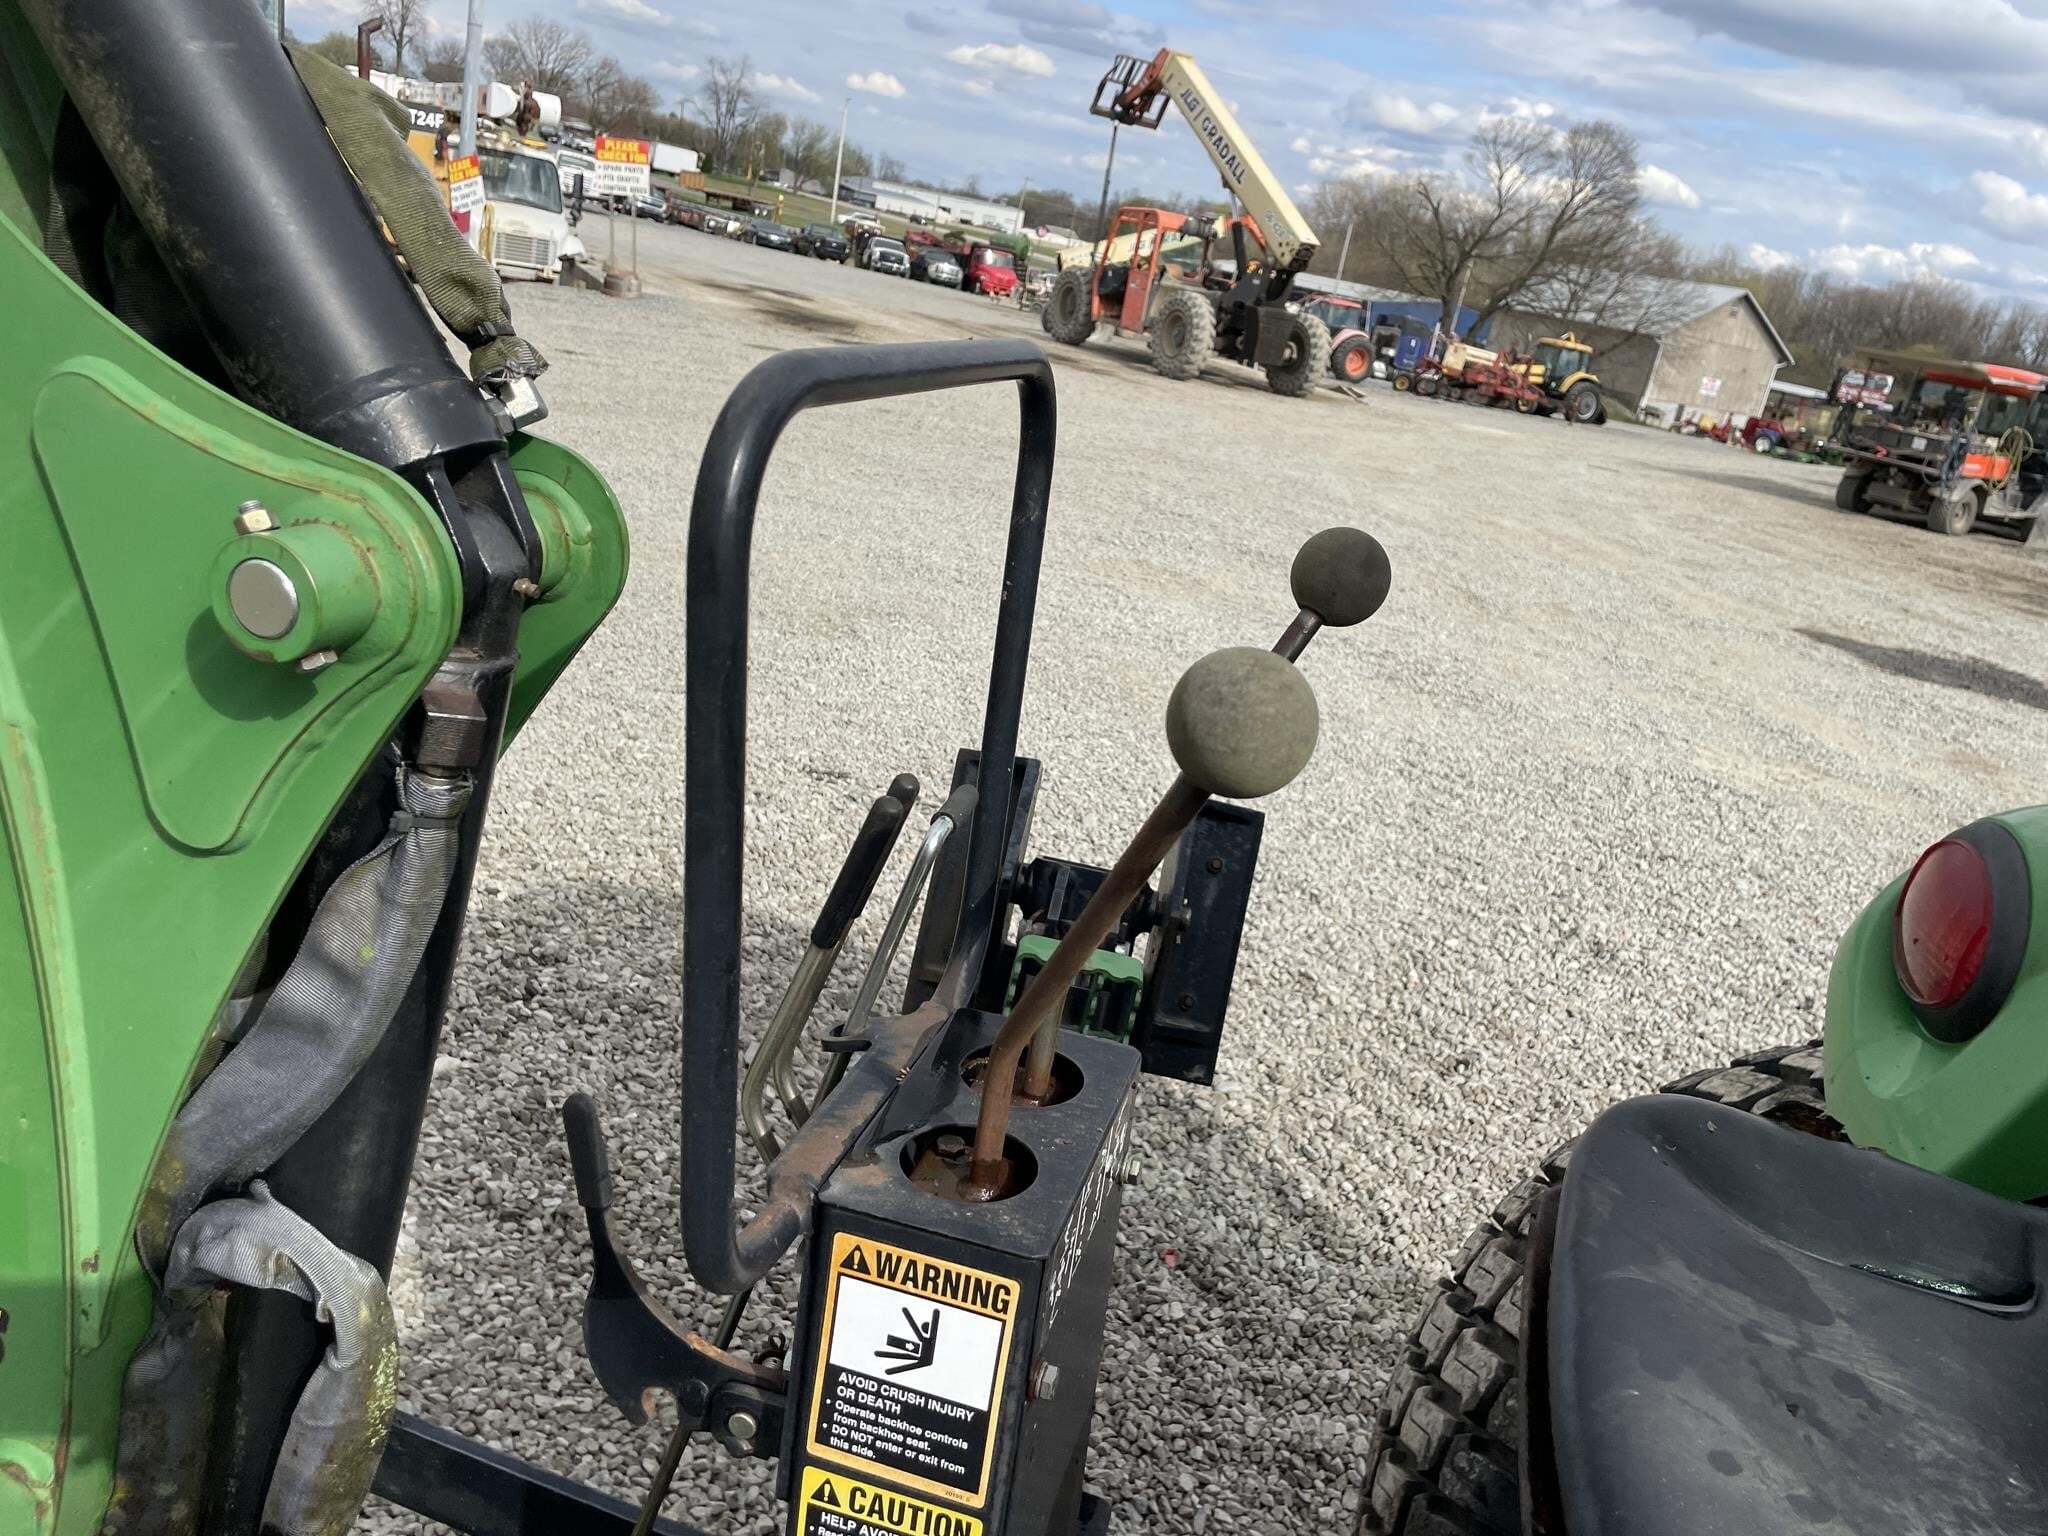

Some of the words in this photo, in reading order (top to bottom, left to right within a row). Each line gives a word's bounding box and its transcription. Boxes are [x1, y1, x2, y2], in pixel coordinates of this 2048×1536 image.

[1202, 117, 1245, 184] GRADALL
[876, 1249, 1011, 1315] WARNING
[837, 1385, 856, 1400] OR
[858, 1391, 901, 1415] DEATH
[839, 1372, 878, 1392] AVOID
[880, 1384, 925, 1408] CRUSH
[927, 1398, 975, 1422] INJURY
[830, 1435, 850, 1450] this
[851, 1444, 876, 1459] side.
[831, 1424, 848, 1437] DO
[850, 1429, 874, 1445] NOT
[875, 1440, 903, 1454] enter
[904, 1449, 917, 1459] or
[918, 1453, 939, 1466] exit
[940, 1458, 965, 1475] from
[833, 1412, 858, 1428] from
[860, 1420, 904, 1442] backhoe
[906, 1436, 931, 1451] seat.
[835, 1400, 876, 1421] Operate
[878, 1413, 923, 1436] backhoe
[924, 1430, 968, 1450] controls
[821, 1511, 857, 1531] HELP
[849, 1486, 972, 1536] CAUTION
